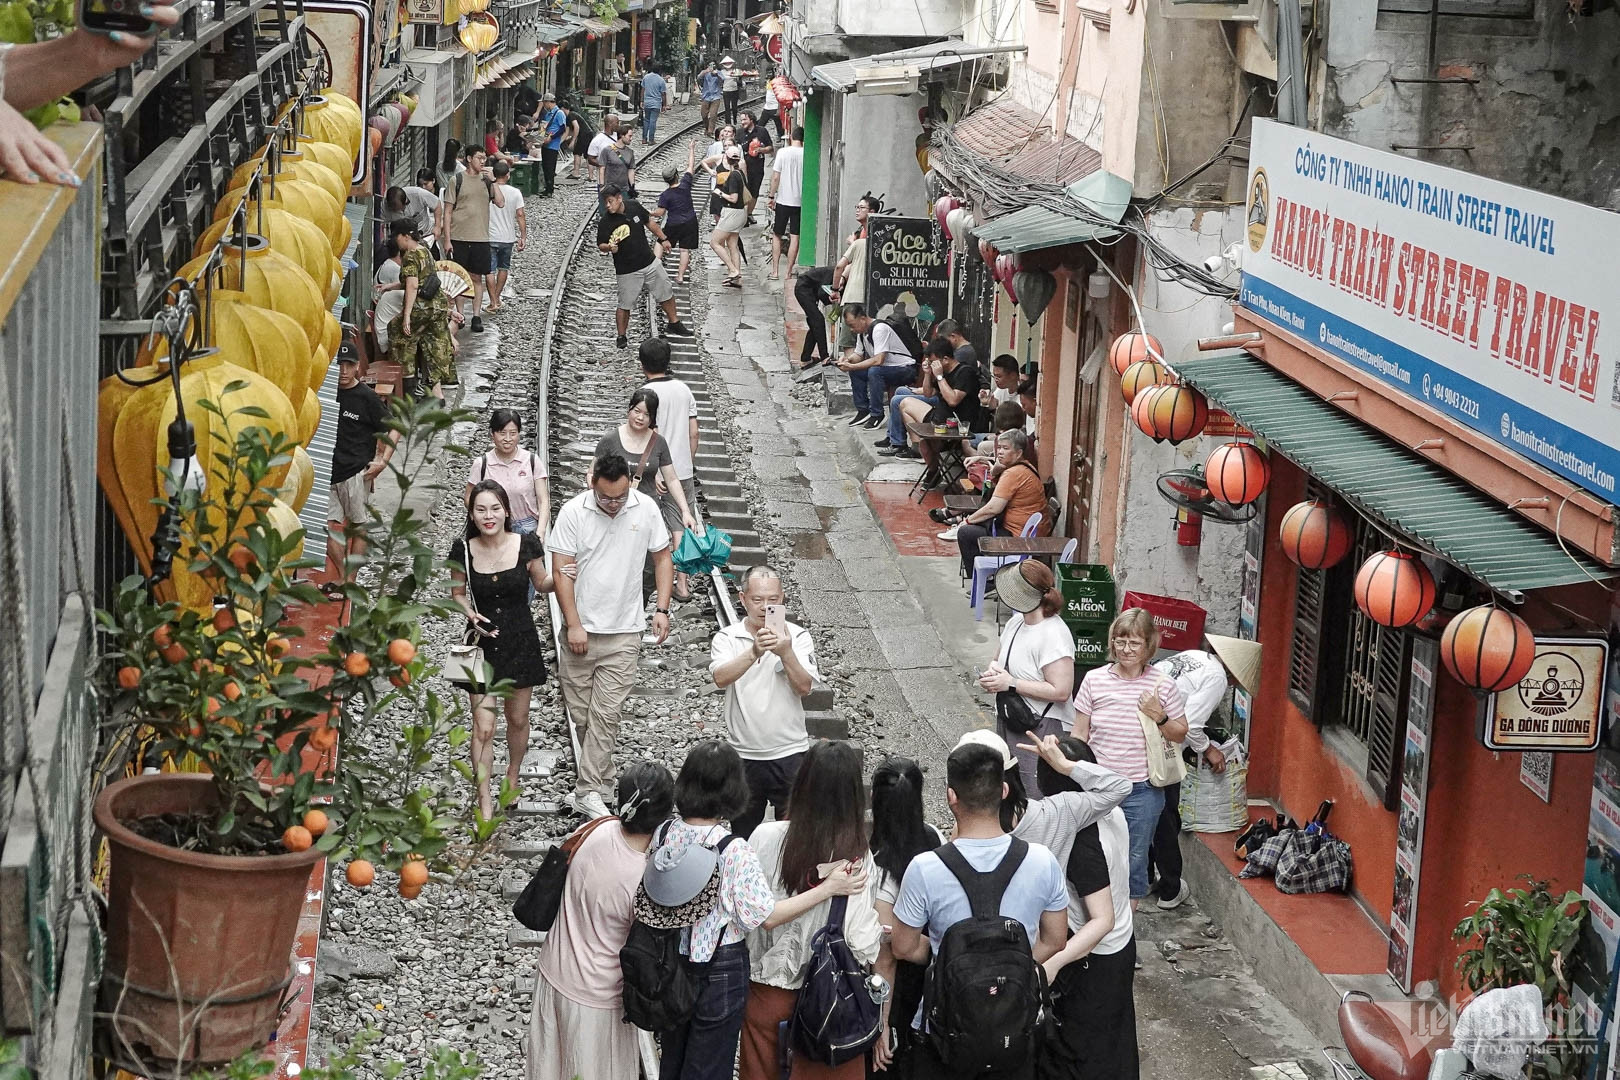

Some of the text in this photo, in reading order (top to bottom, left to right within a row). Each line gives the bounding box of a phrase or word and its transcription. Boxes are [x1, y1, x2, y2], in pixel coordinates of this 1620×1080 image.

[1295, 142, 1556, 255] CÔNG TY TNHH HANOI TRAIN STREET TRAVEL
[893, 228, 927, 250] Ice
[881, 241, 941, 266] Cream
[1248, 290, 1259, 307] Tran
[1271, 196, 1600, 403] HANOI TRAIN STREET TRAVEL
[1432, 383, 1444, 401] +84
[1460, 395, 1480, 419] 22121
[1511, 421, 1615, 493] hanoitrainstreettravel.com
[1068, 602, 1107, 612] SAIGON
[1153, 615, 1173, 628] HANOI
[1500, 718, 1514, 732] GA
[1552, 717, 1590, 734] DƯƠNG
